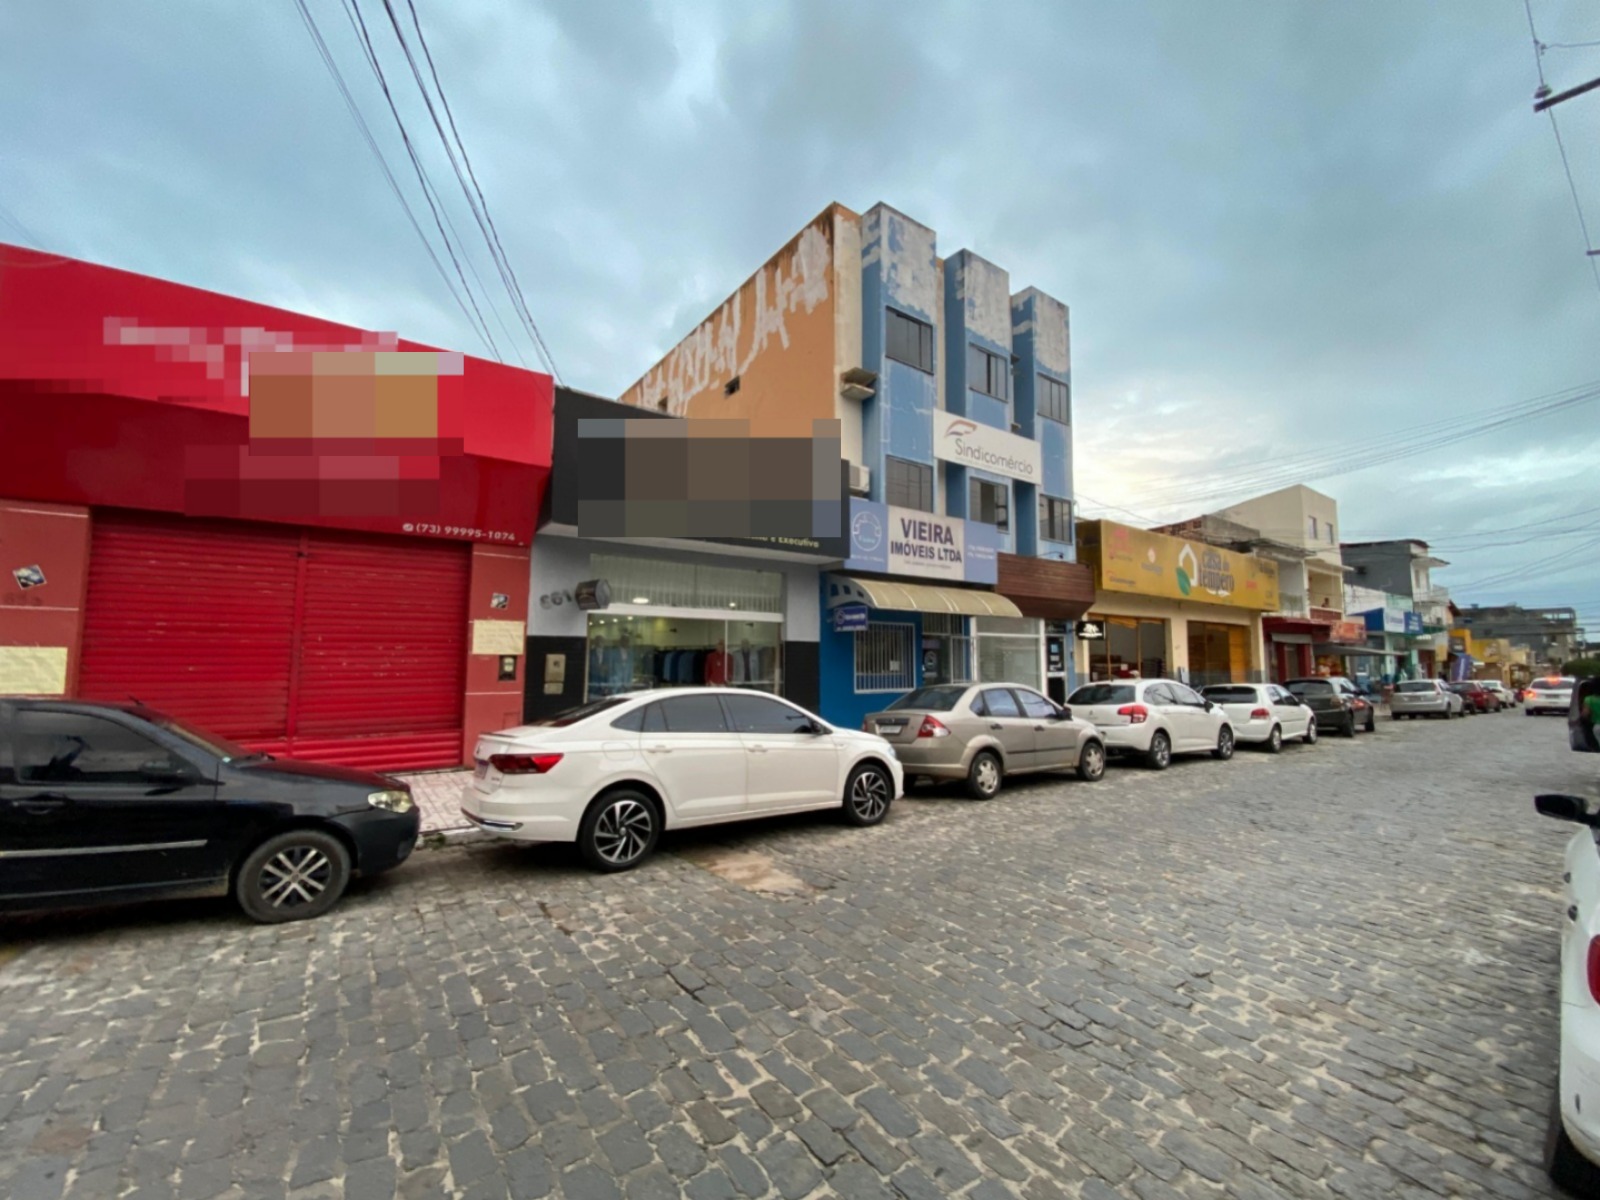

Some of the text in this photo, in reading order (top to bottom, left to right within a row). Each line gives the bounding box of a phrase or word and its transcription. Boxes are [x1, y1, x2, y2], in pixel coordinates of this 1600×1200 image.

[955, 438, 1033, 474] Sindicomércio
[416, 523, 515, 540] (73) 99995-1074
[900, 517, 954, 546] VIEIRA
[891, 540, 935, 560] IMÓVEIS
[938, 547, 962, 563] LTDA
